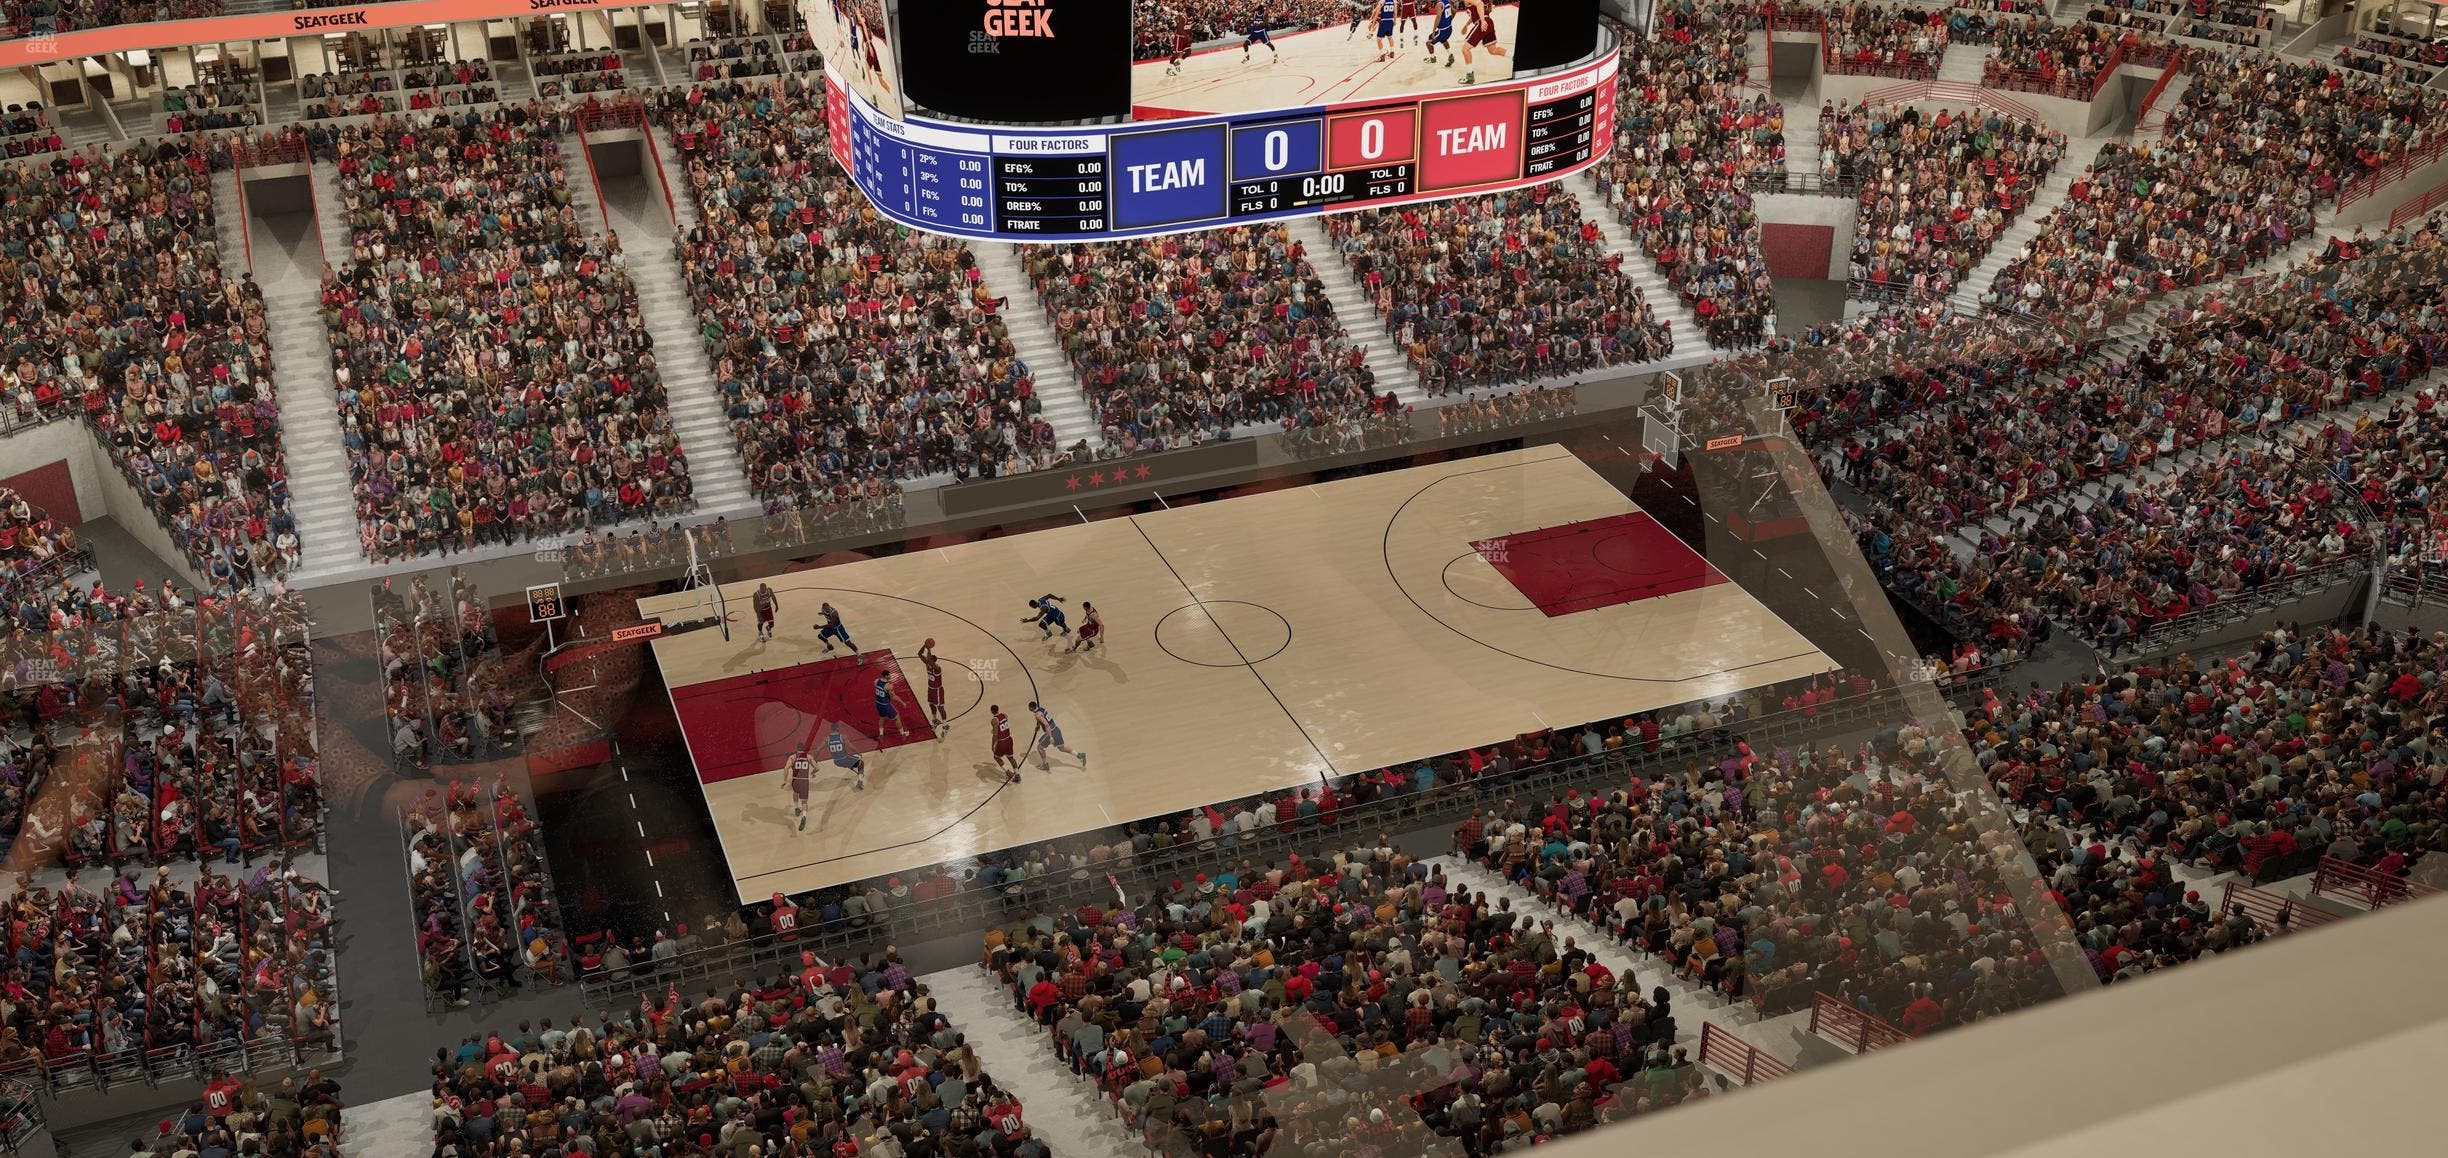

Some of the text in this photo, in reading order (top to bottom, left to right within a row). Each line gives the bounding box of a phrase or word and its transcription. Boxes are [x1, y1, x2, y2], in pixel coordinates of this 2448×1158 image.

[294, 11, 368, 29] SEATGEEK
[983, 9, 1055, 38] GEEK
[1538, 76, 1589, 97] FOUR FACTORS
[1533, 95, 1593, 120] EFG% 0.00
[886, 121, 905, 136] STATS
[1532, 127, 1548, 138] TO%
[1579, 113, 1591, 127] 0.00
[1009, 139, 1089, 150] FOUR FACTORS
[1361, 119, 1384, 160] 0
[1436, 122, 1507, 156] TEAM
[1577, 131, 1590, 144] 0.00
[1264, 130, 1288, 171] 0
[919, 154, 981, 172] 2P% 0.00
[1005, 162, 1101, 174] EFG% 0.00
[1529, 148, 1589, 174] FTRATE 0.00
[920, 171, 982, 189] 3P% 0.00
[1127, 158, 1205, 193] TEAM
[1370, 165, 1405, 179] TOL 0
[1078, 181, 1102, 193] 0.00
[1241, 181, 1278, 195] TOL 0
[1303, 173, 1344, 197] 0:00
[1369, 181, 1405, 196] FLS 0
[921, 189, 983, 207] FG% 0.00
[1006, 200, 1102, 212] OREB% 0.00
[1241, 197, 1278, 212] FLS 0
[962, 213, 984, 225] 0.00
[1007, 219, 1103, 230] FTRATE 0.00
[1711, 437, 1738, 447] SEATGEEK
[539, 602, 556, 617] 88
[617, 625, 657, 638] SEATGEEK
[794, 761, 808, 770] 00
[780, 913, 795, 929] 00
[210, 1090, 227, 1108] 00
[1001, 1114, 1019, 1135] 00
